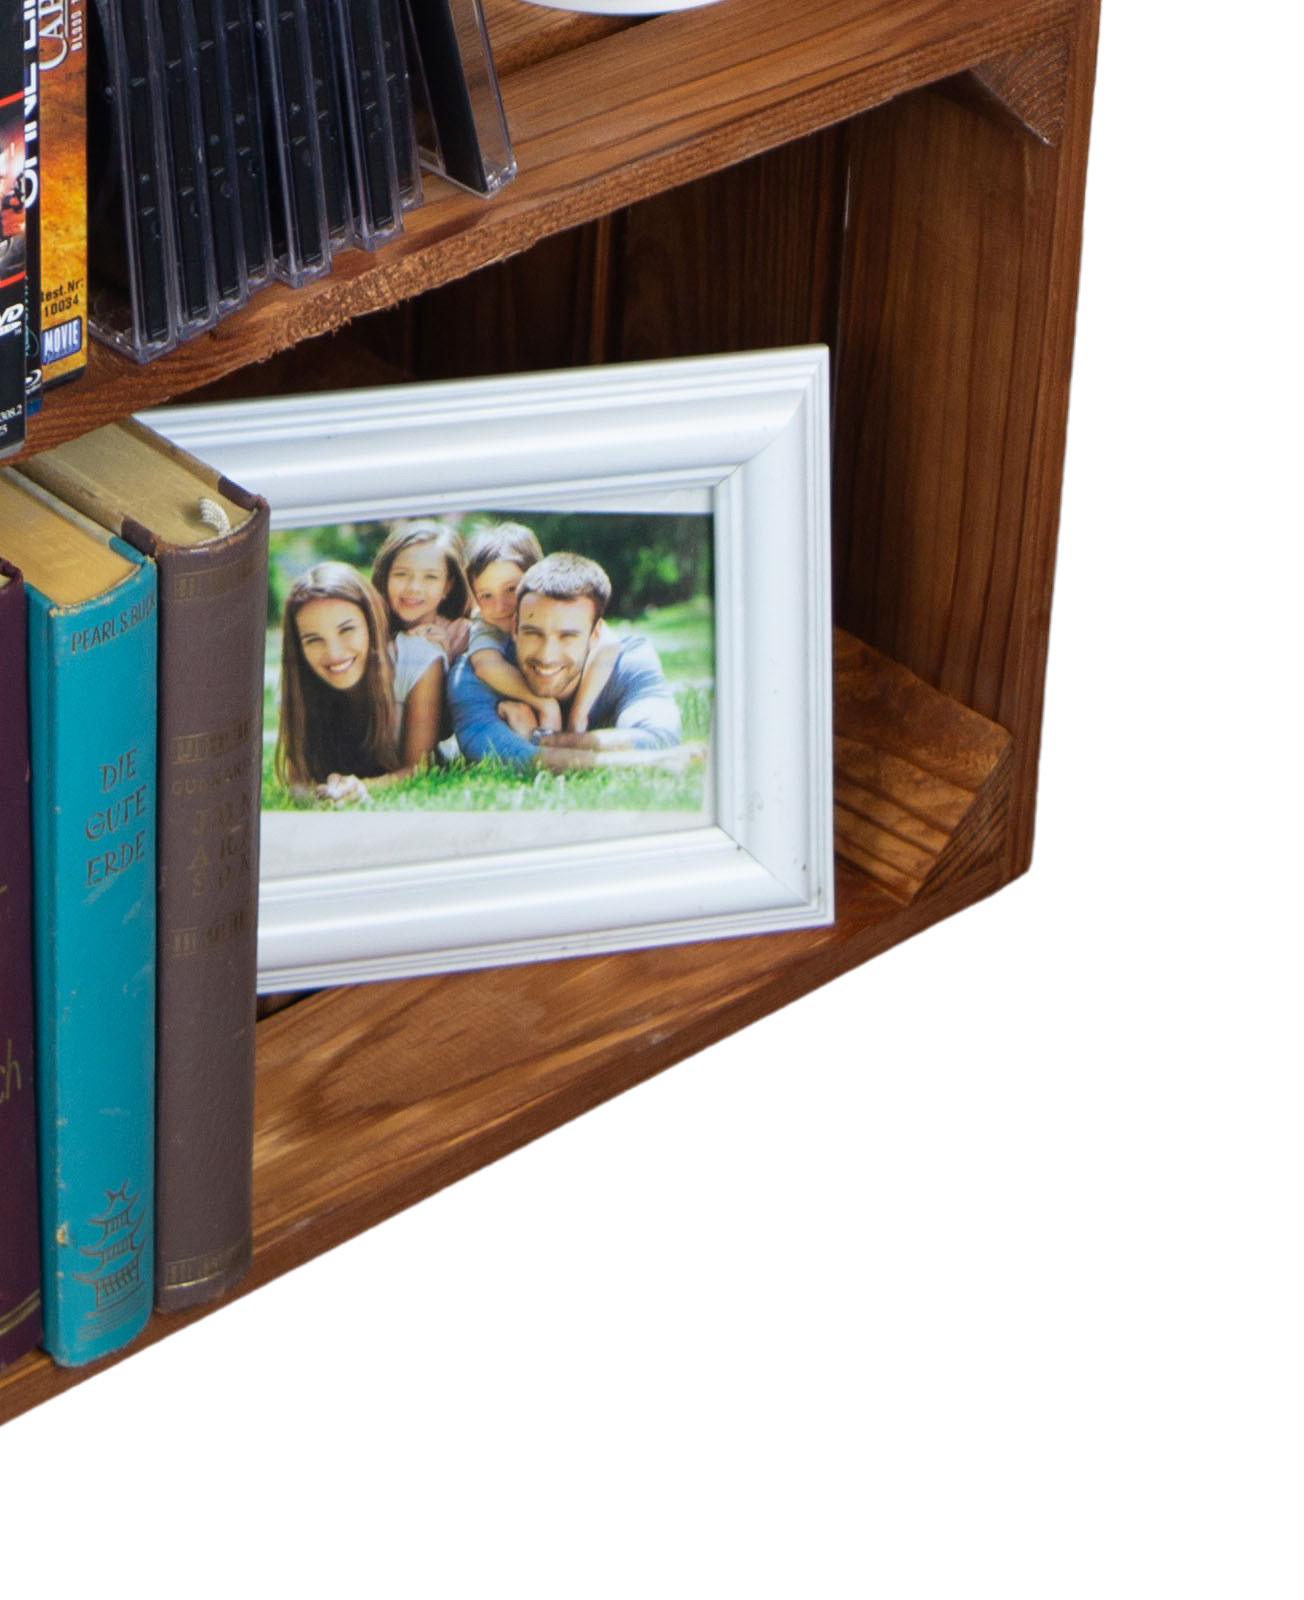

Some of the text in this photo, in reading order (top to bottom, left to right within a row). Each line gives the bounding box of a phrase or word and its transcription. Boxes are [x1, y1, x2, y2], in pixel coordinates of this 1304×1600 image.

[44, 320, 78, 356] MOVIE
[71, 617, 117, 653] PEARL
[99, 749, 137, 793] DIE
[85, 784, 146, 841] GUTE
[87, 830, 145, 886] ERDE
